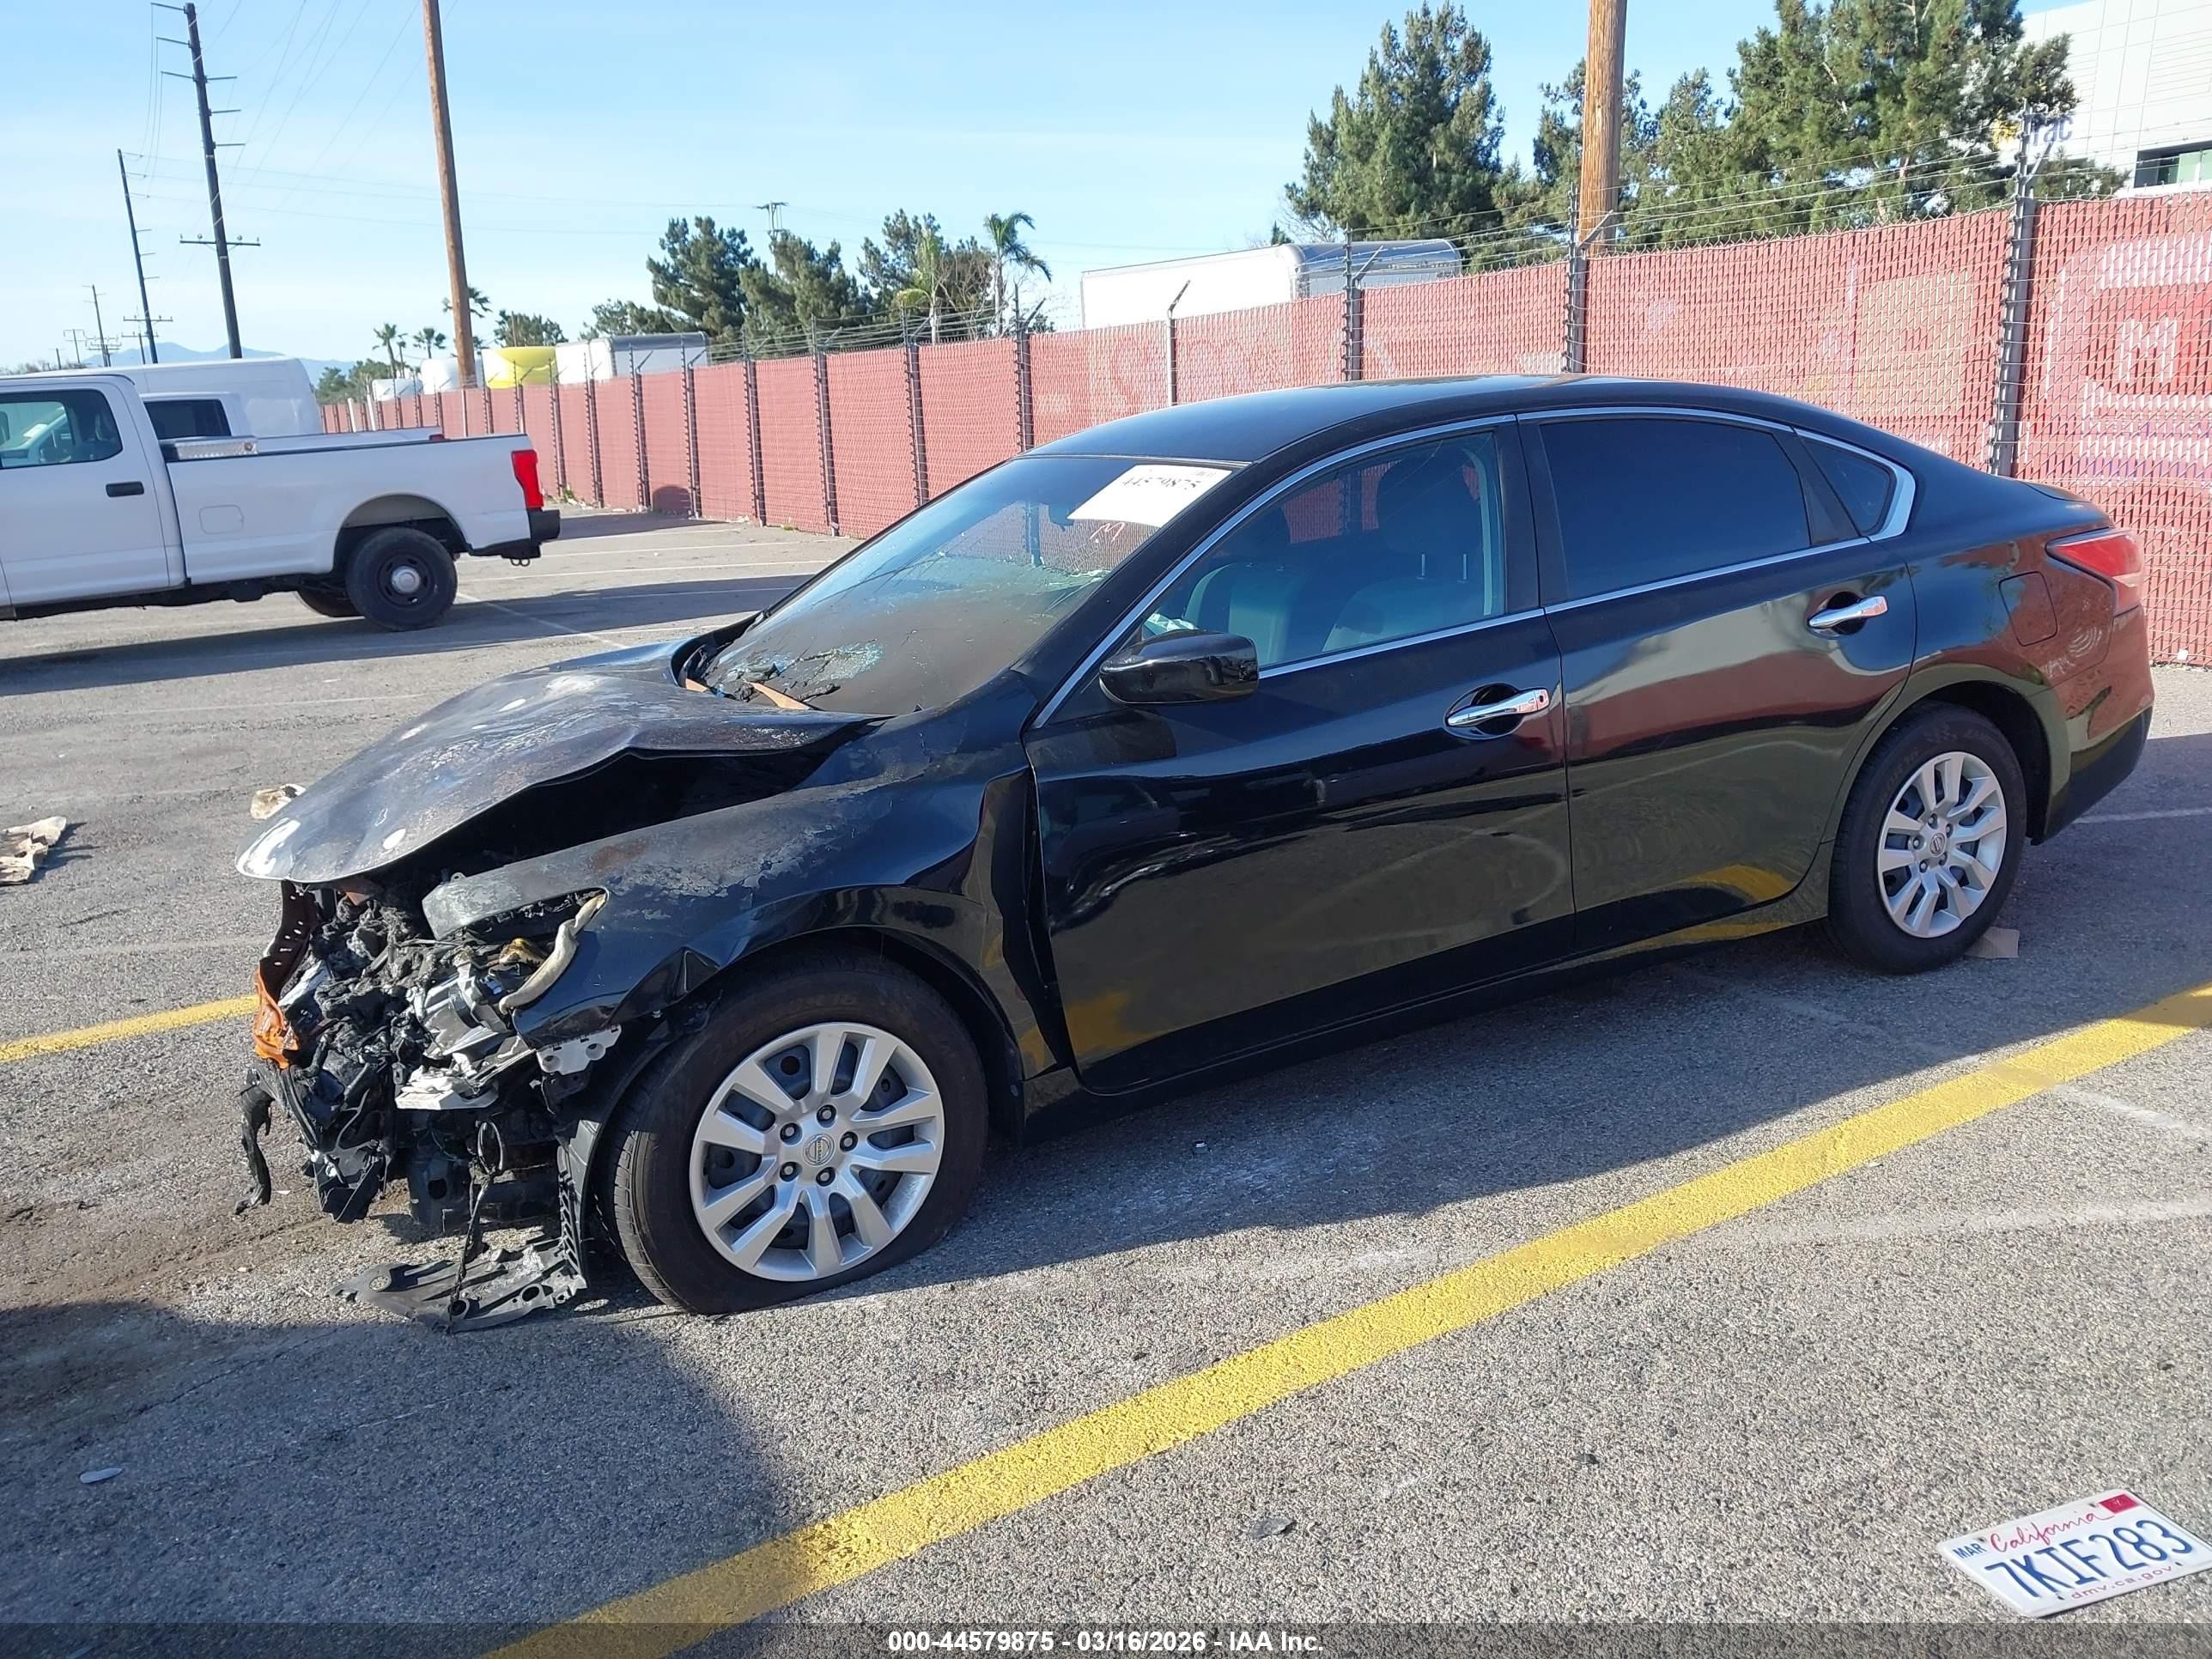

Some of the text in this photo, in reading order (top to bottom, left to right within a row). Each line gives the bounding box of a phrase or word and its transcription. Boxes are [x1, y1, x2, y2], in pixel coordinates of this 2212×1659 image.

[1953, 1543, 1987, 1559] MAR
[1990, 1510, 2115, 1553] California
[1984, 1519, 2193, 1598] 7KIF283
[2071, 1565, 2172, 1600] dmv.ca.gov
